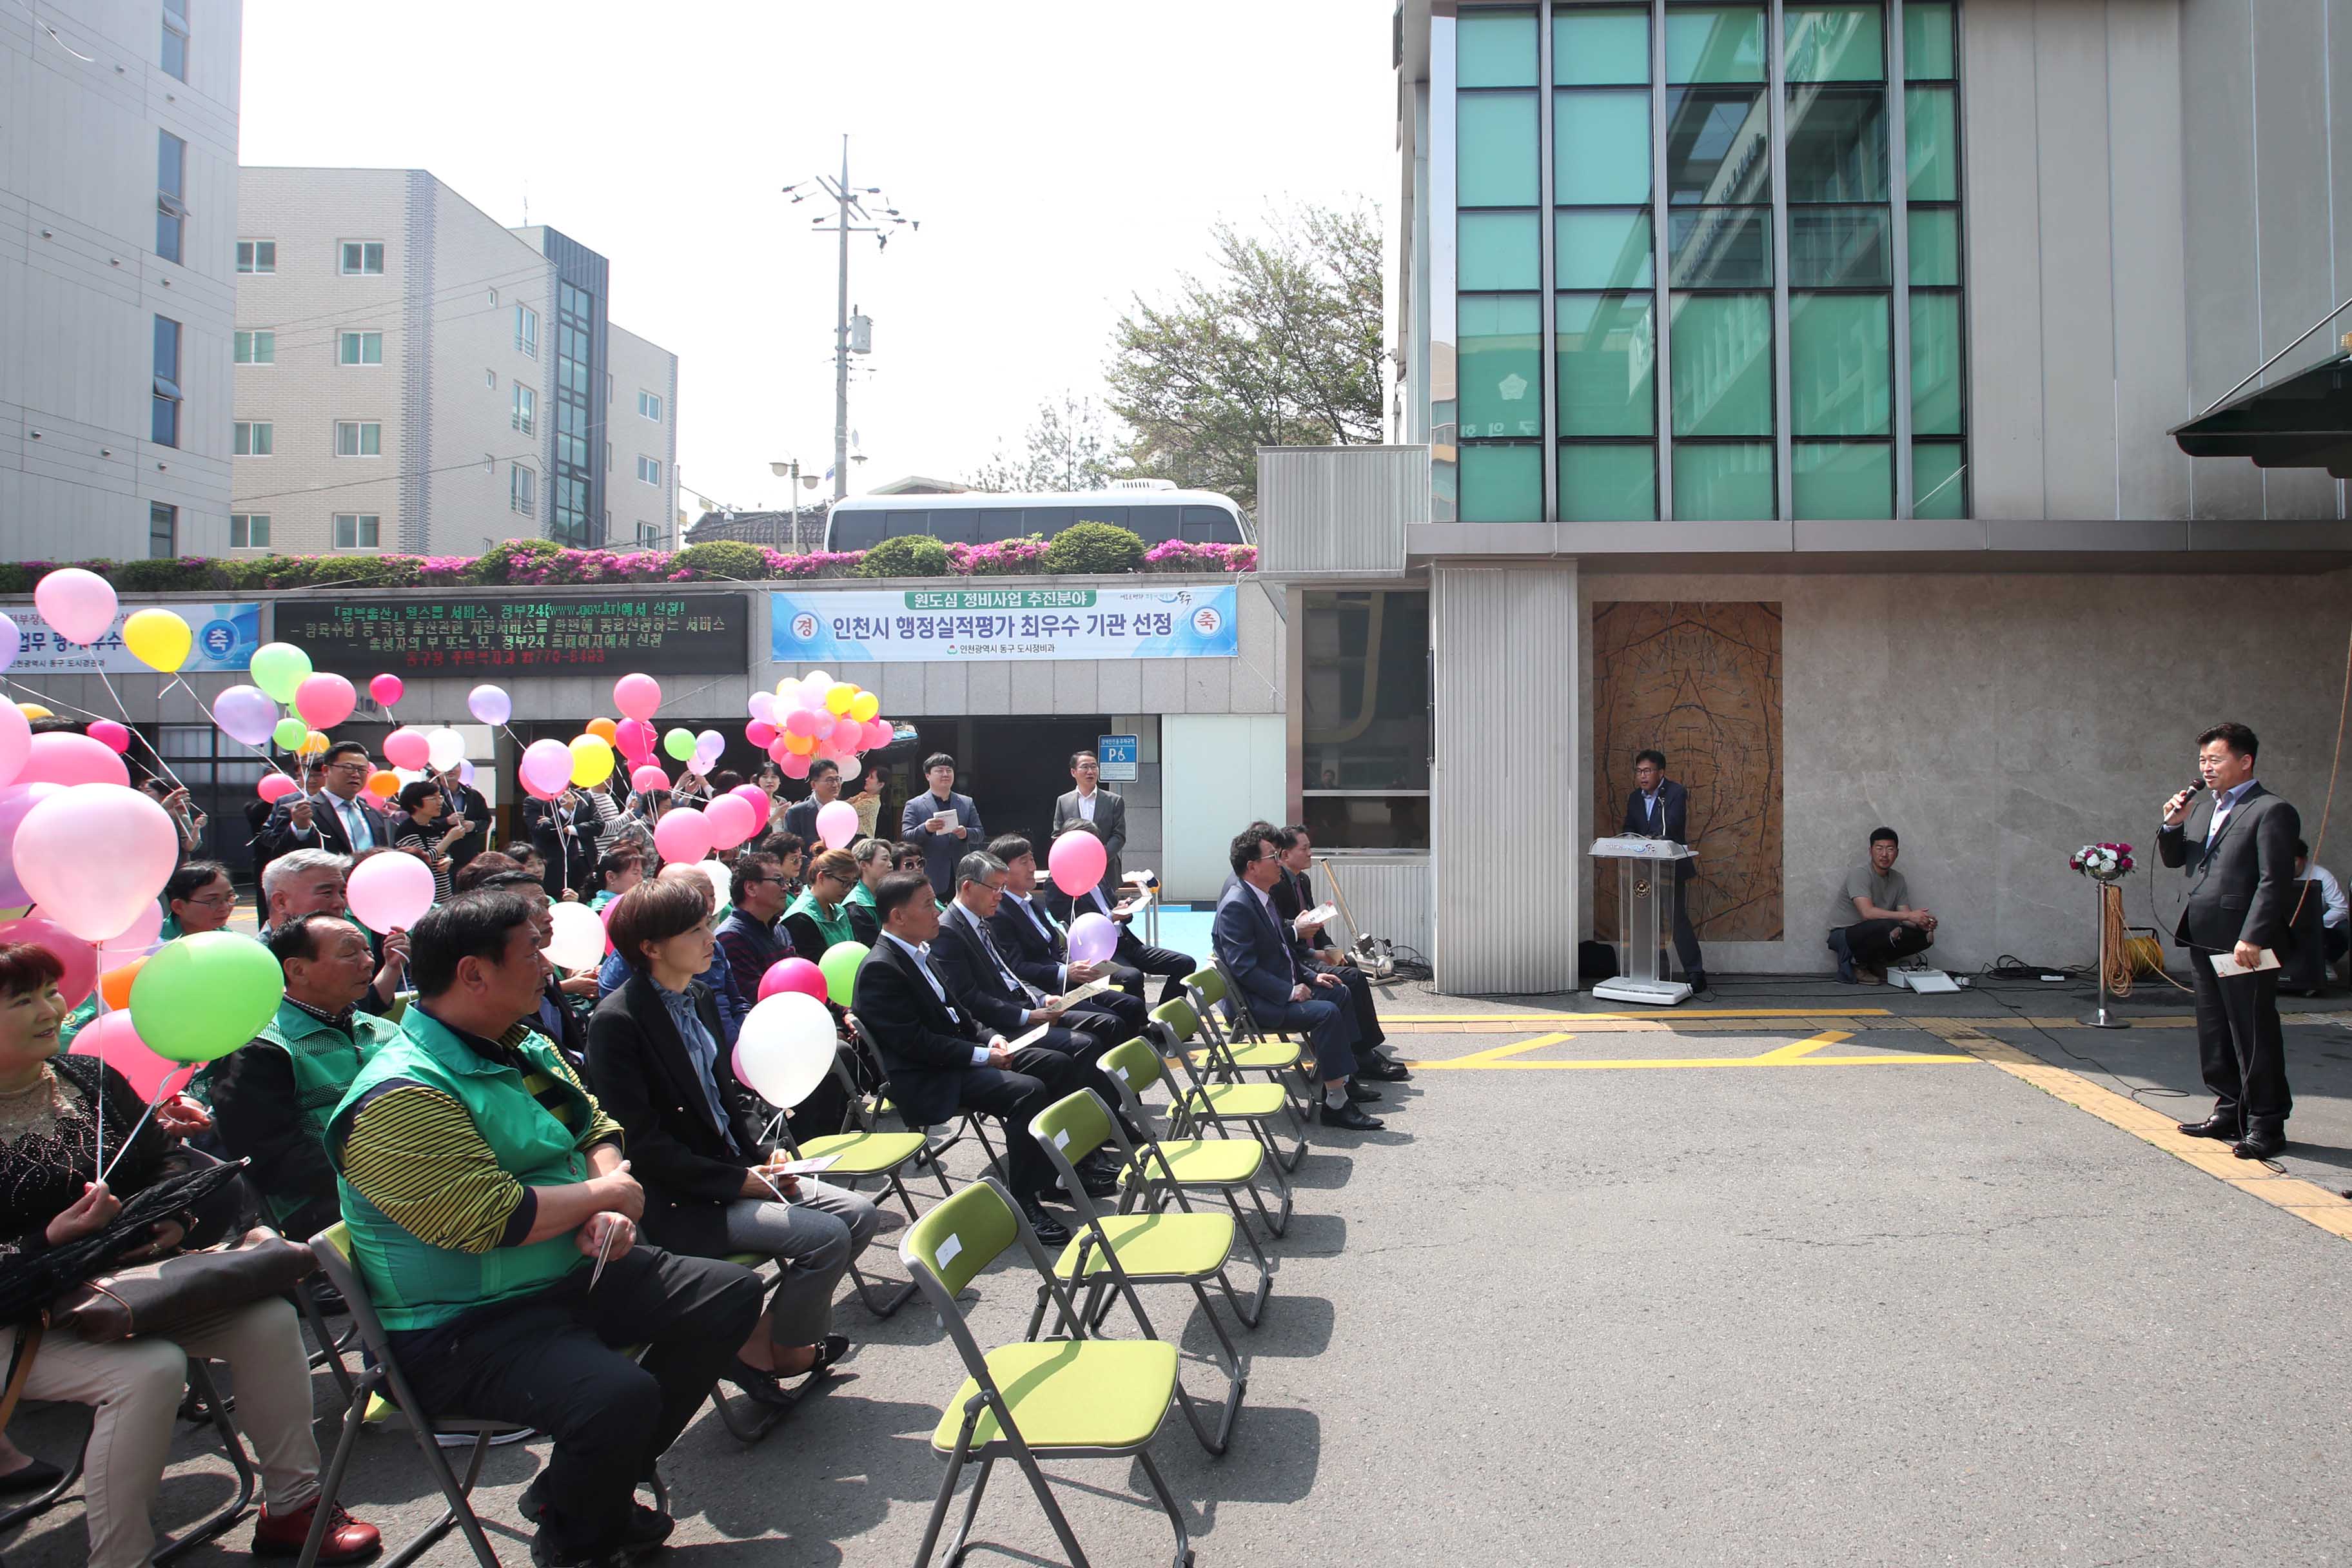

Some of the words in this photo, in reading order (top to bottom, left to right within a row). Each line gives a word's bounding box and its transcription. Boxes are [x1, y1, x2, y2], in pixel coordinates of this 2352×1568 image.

[914, 593, 958, 608] 원도심
[963, 592, 1022, 607] 정비사업
[1027, 591, 1087, 607] 추진분야
[686, 616, 725, 632] 서비스
[797, 618, 812, 637] 경
[832, 616, 890, 640] 인천시
[896, 615, 1015, 640] 행정실적평가
[1021, 614, 1081, 638] 최우수
[1086, 613, 1126, 637] 기관
[1133, 612, 1172, 636] 선정
[1197, 611, 1217, 630] 축
[209, 628, 229, 651] 축
[960, 644, 997, 654] 인천광역시
[999, 644, 1015, 654] 동구
[1017, 643, 1055, 653] 도시정비과
[1109, 748, 1117, 761] P
